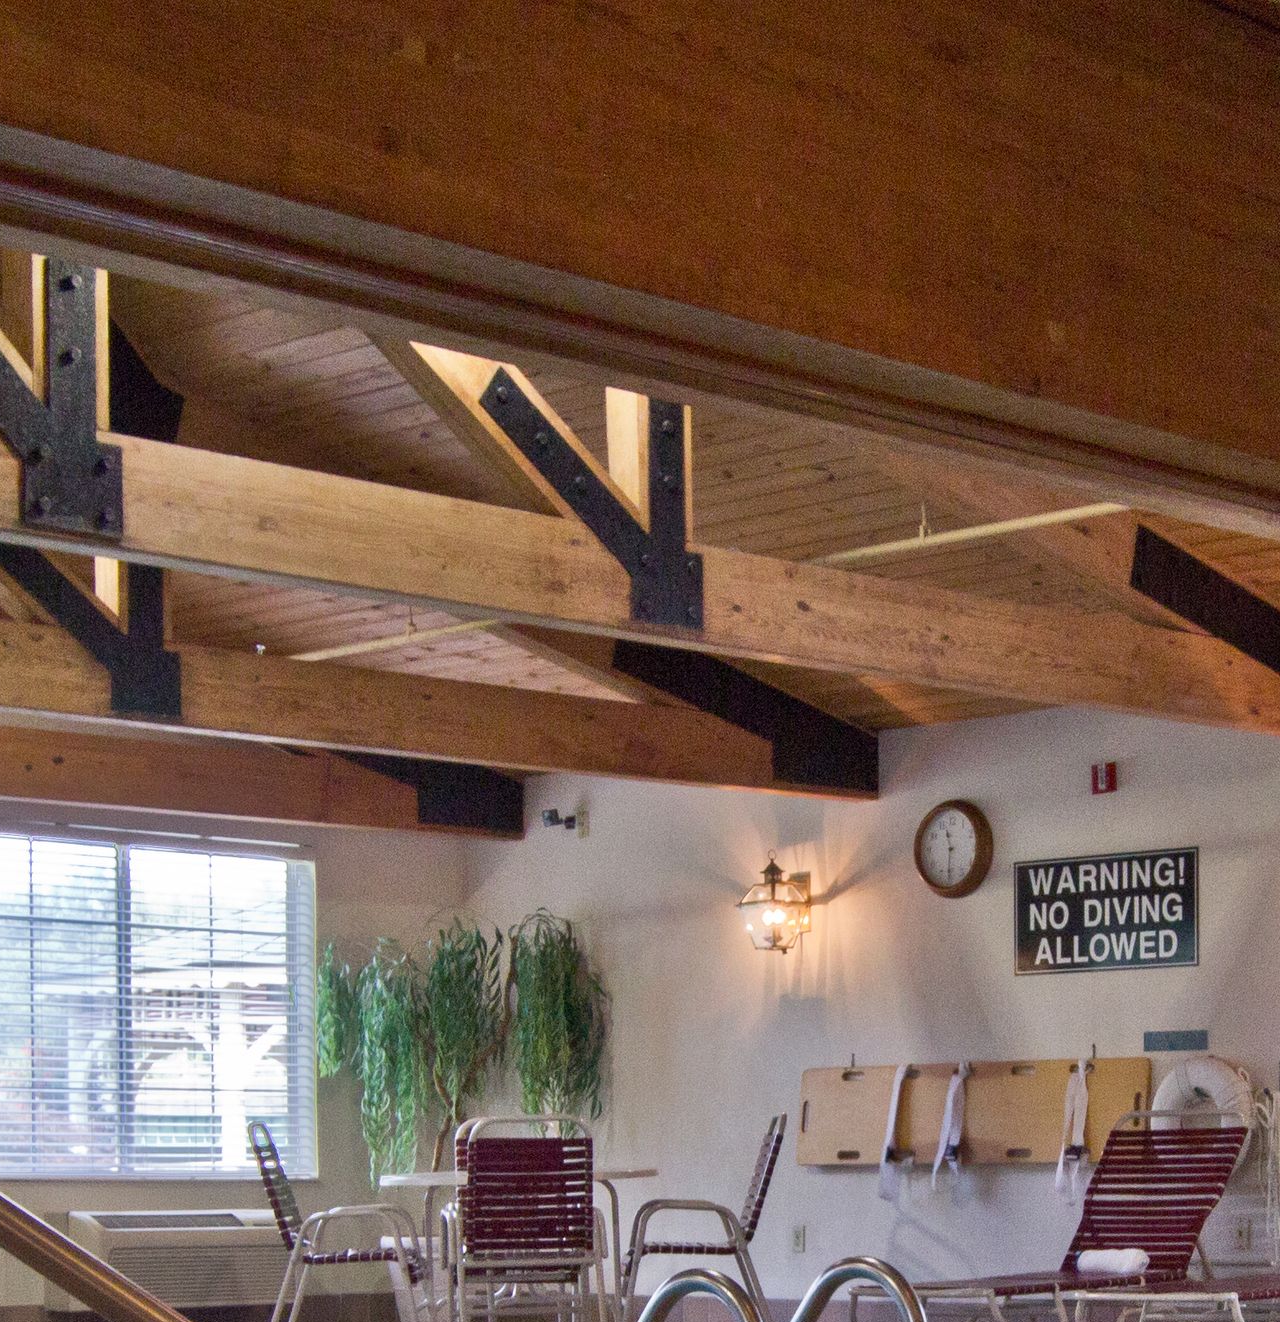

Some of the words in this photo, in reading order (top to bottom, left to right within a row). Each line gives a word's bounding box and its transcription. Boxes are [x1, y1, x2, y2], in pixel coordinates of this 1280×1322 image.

[1028, 857, 1186, 896] WARNING!
[1029, 901, 1069, 931] NO
[1084, 892, 1183, 928] DIVING
[1034, 929, 1179, 966] ALLOWED
